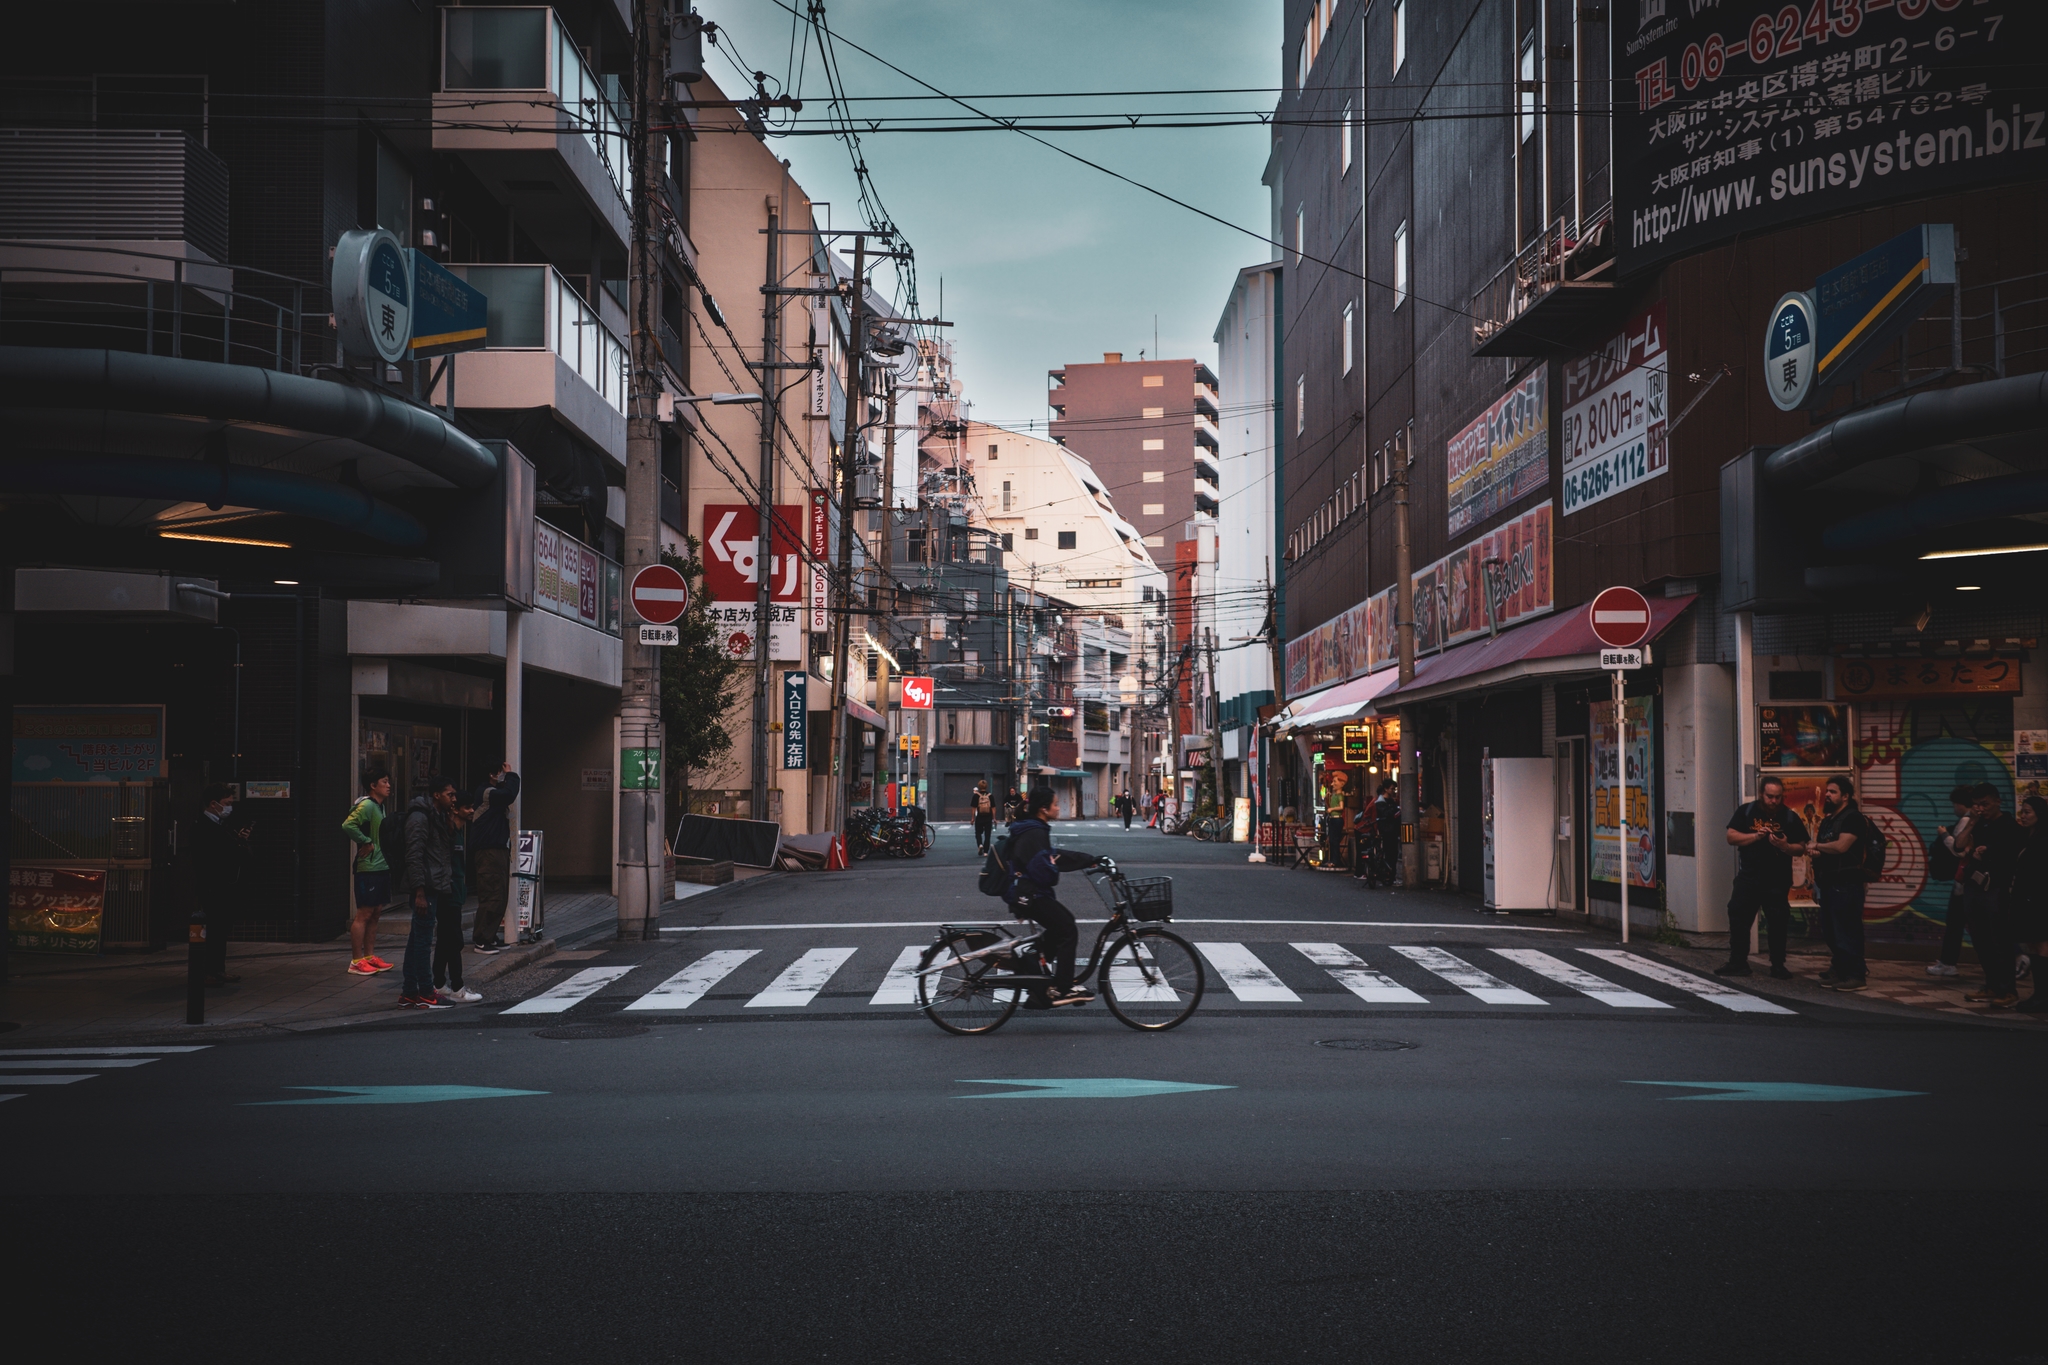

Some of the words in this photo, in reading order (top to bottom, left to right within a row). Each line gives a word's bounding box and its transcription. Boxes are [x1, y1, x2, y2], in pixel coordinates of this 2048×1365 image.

[1626, 17, 1678, 57] SunSystem.inc
[1636, 56, 1676, 115] TEL
[381, 304, 396, 342] 東
[1780, 314, 1795, 328] ここは
[1566, 314, 1660, 404] トランクルーム
[1782, 358, 1798, 392] 東
[1564, 441, 1645, 510] 06-6266-1112
[814, 505, 826, 555] スギドラッグ
[538, 532, 558, 564] 6644
[708, 511, 797, 596] くすり
[815, 568, 824, 593] SUGI
[815, 597, 824, 626] DRUG
[641, 629, 678, 641] 自転車を除く
[1602, 654, 1640, 665] 自転車を除く
[1886, 661, 2009, 686] まるたつ
[904, 680, 931, 706] くすり
[24, 724, 110, 736] こぐまの森保育園
[82, 743, 156, 756] 階段を上がり
[93, 758, 134, 772] 当ビル
[136, 758, 156, 771] 2F
[637, 758, 658, 781] 文
[1596, 785, 1649, 830] 高価買取
[31, 892, 101, 909] クッキング
